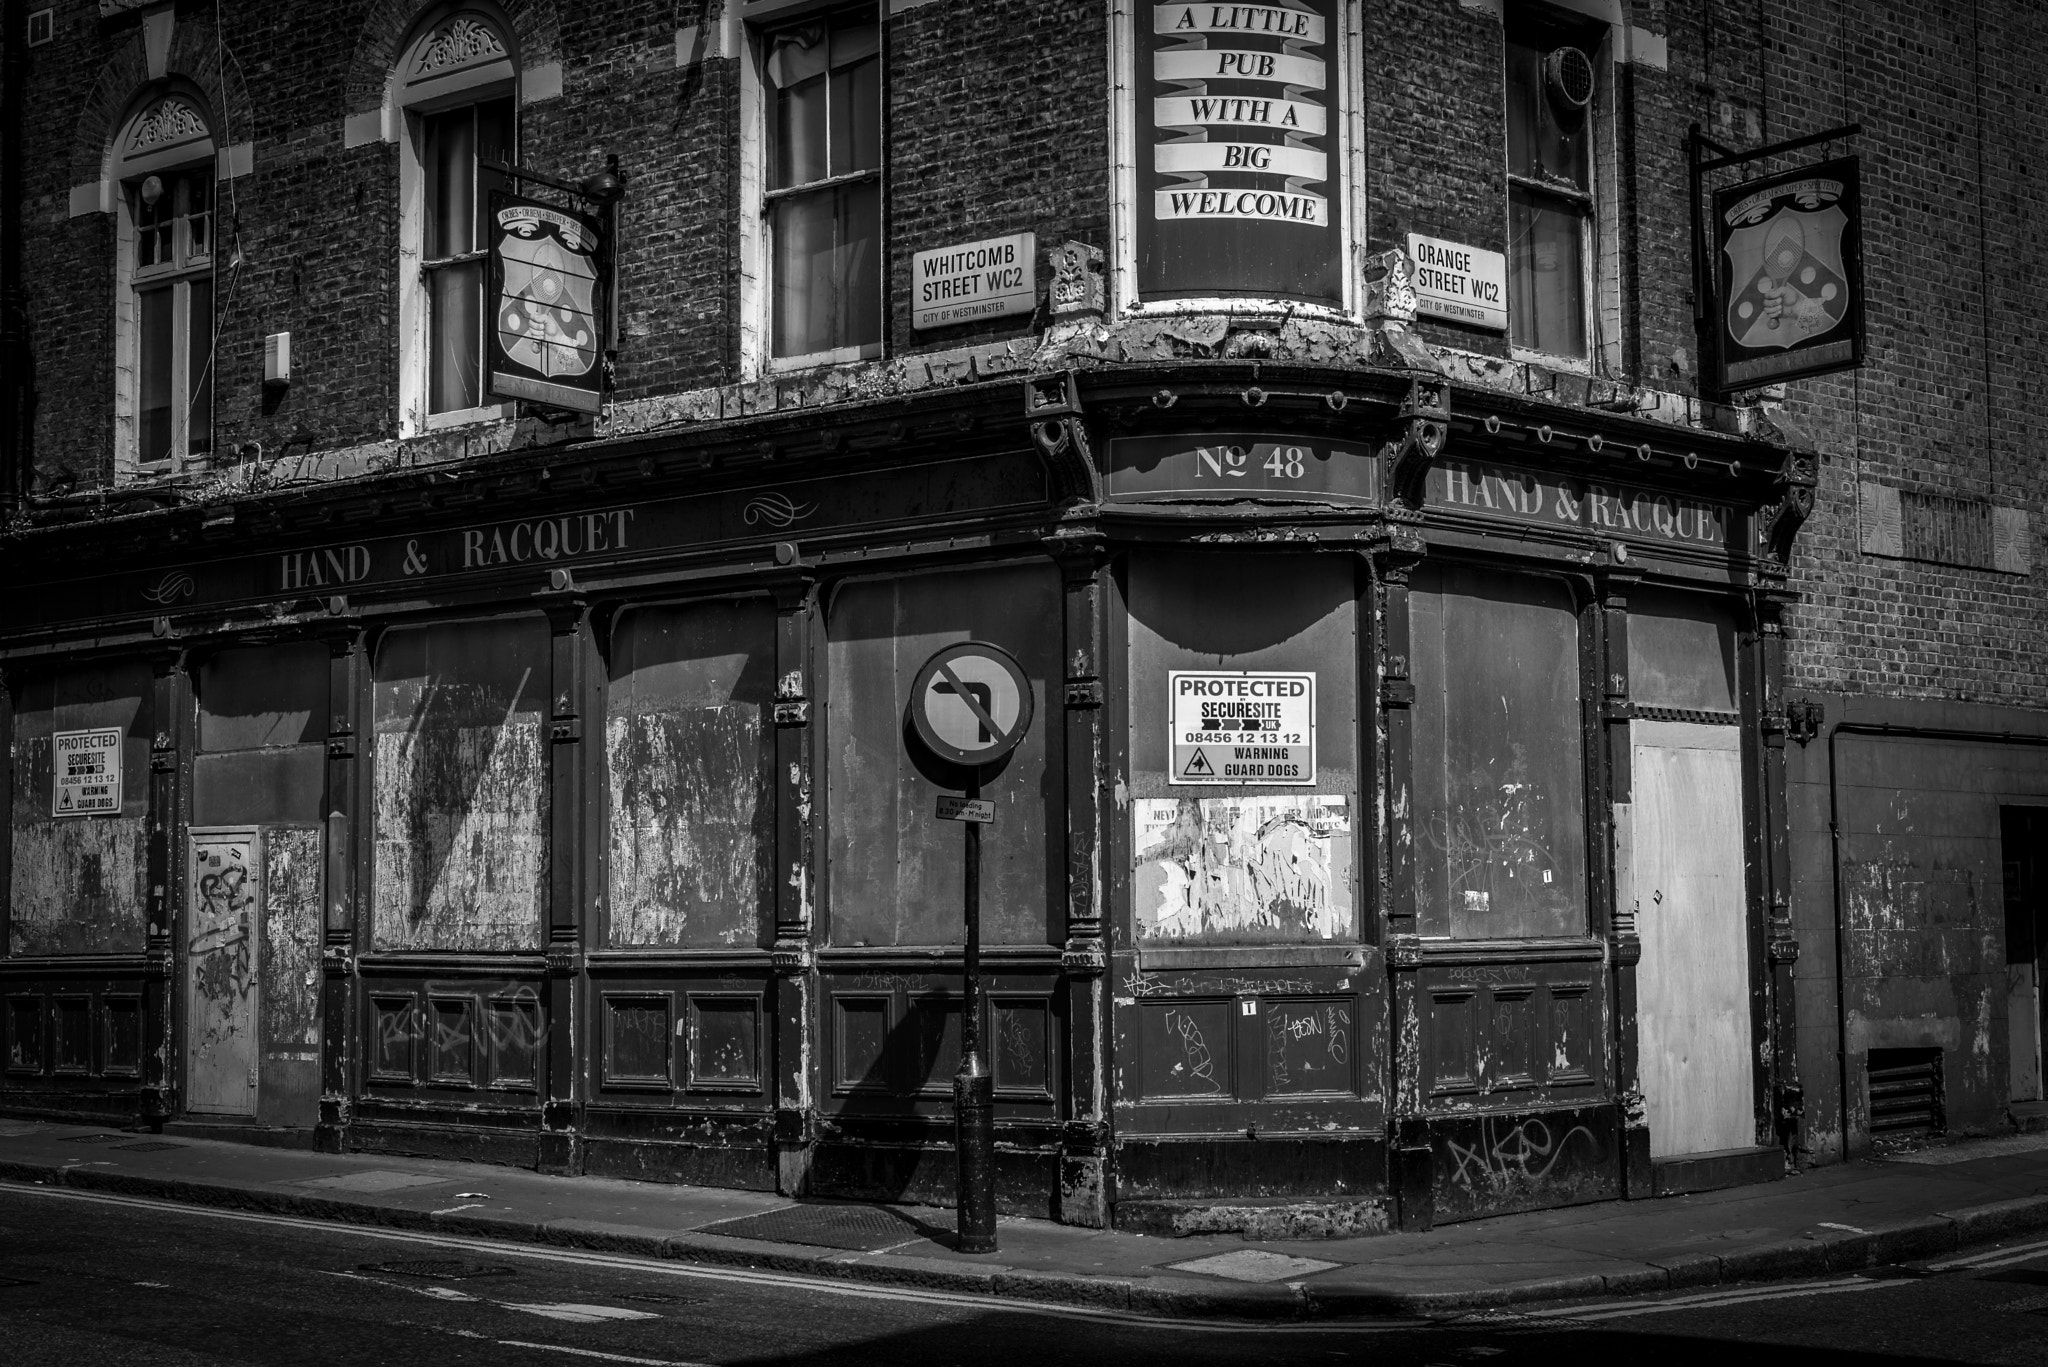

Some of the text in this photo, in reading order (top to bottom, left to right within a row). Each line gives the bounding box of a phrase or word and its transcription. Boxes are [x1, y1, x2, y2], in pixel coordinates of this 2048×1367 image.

[1176, 6, 1310, 37] A LITTLE
[1216, 53, 1276, 78] PUB
[1190, 99, 1299, 127] WITH A
[1222, 146, 1272, 170] BIG
[1170, 191, 1316, 221] WELCOME
[923, 244, 1014, 278] WHITCOMB
[1418, 243, 1471, 273] ORANGE
[923, 267, 1023, 302] STREET WC2
[1419, 268, 1499, 303] STREET WC2
[923, 301, 1005, 324] CITY OF WESTMINSTER
[1420, 298, 1485, 320] CITY OF WESTMINSTER
[1263, 446, 1305, 478] 48
[1445, 461, 1735, 543] HAND & RACQUET
[280, 509, 634, 590] HAND & RACQUET
[1180, 680, 1305, 697] PROTECTED
[1201, 702, 1281, 718] SECURESITE
[1265, 720, 1277, 730] UK
[58, 735, 117, 750] PROTECTED
[1185, 733, 1301, 744] 08456 12 13 12
[68, 752, 105, 766] SECURESITE
[1234, 747, 1288, 760] WARNING
[60, 774, 115, 786] 08456 12 13 12
[1225, 764, 1299, 776] GUARD DOGS
[82, 786, 108, 796] WARNING
[77, 797, 113, 809] GUARD DOGS
